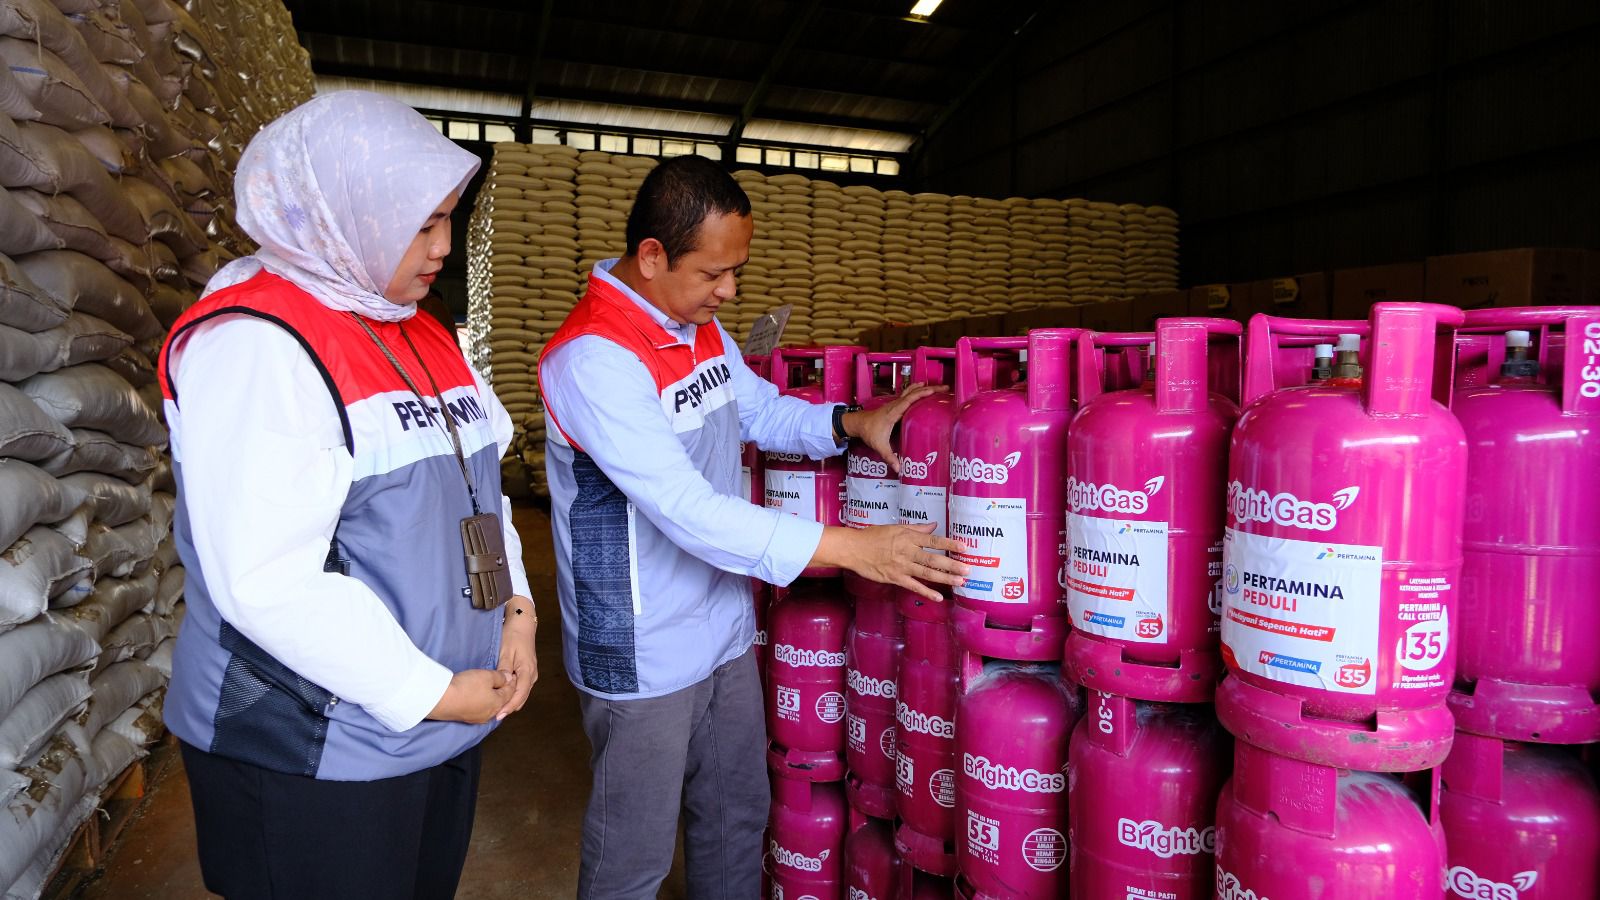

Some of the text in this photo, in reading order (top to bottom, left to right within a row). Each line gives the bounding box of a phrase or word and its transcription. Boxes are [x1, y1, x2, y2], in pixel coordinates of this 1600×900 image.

[1580, 322, 1600, 398] 02-30
[675, 363, 731, 413] PERMINA
[860, 457, 888, 477] Gas
[903, 457, 927, 479] Gas
[970, 458, 1008, 484] Gas
[1067, 477, 1148, 514] ight Gas
[899, 508, 928, 520] TAMINA
[1272, 493, 1336, 531] Gas
[952, 522, 1004, 538] PERTAMINA
[1073, 545, 1140, 567] PERTAMINA
[1337, 553, 1376, 561] PERTAMINA
[1073, 560, 1107, 578] PEDULI
[1243, 572, 1344, 600] PERTAMINA
[1243, 588, 1297, 612] PEDULI
[1398, 603, 1441, 612] PERTAMINA
[1258, 619, 1297, 634] Sepenuh
[1398, 611, 1441, 620] CALL CENTER
[1136, 622, 1159, 635] 135
[775, 644, 845, 667] Bright Gas
[1400, 631, 1441, 660] 135
[1335, 668, 1366, 683] 135
[928, 716, 955, 739] Ga
[964, 752, 1065, 793] Bright Gas
[1118, 818, 1199, 858] Bright
[793, 853, 821, 872] Gas
[1450, 866, 1518, 900] Gas
[1158, 892, 1177, 900] PASTI
